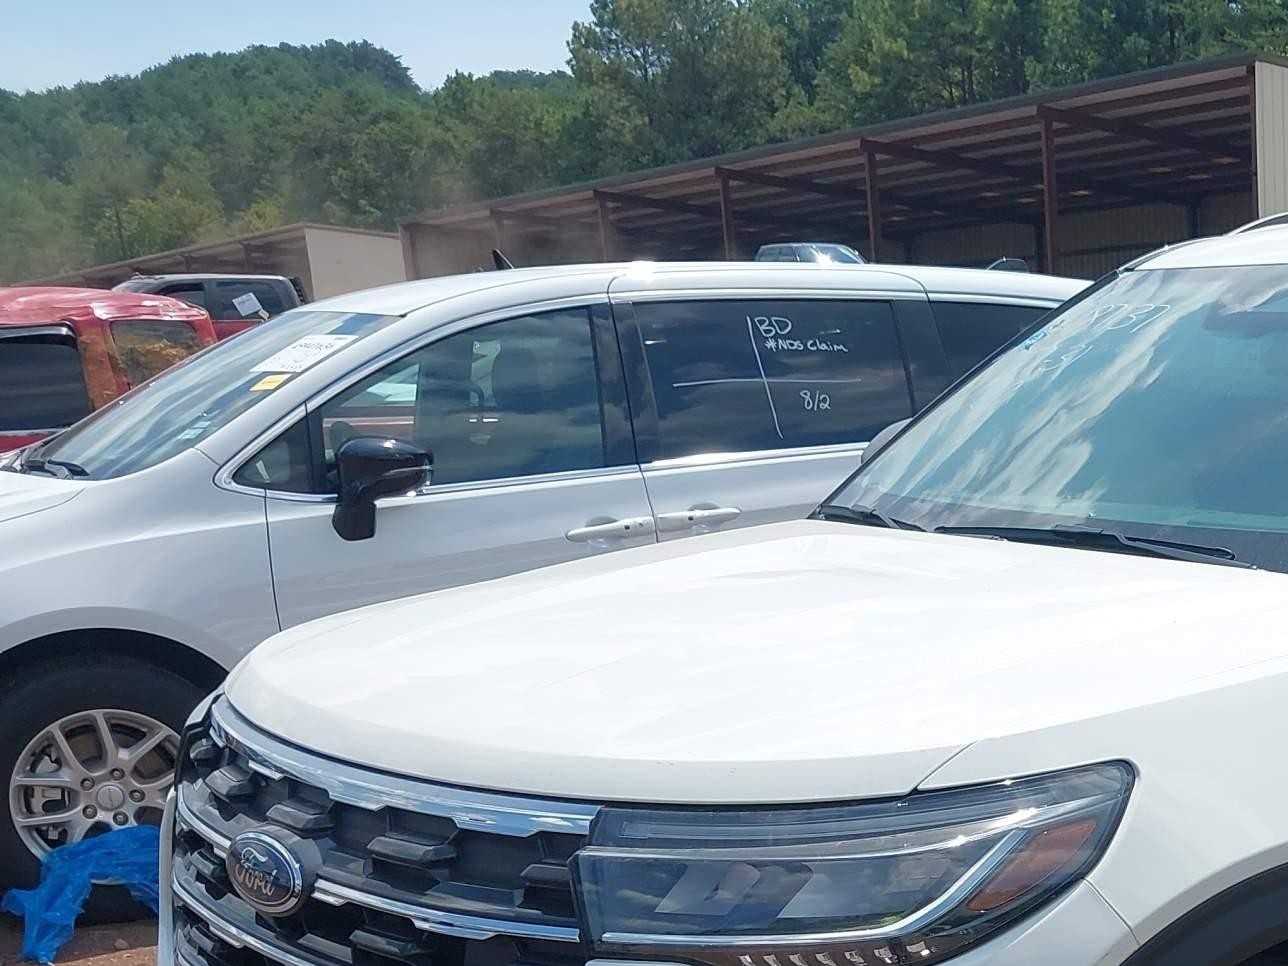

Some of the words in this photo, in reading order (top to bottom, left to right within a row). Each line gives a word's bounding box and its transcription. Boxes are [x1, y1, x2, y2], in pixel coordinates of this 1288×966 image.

[754, 316, 792, 337] BD
[807, 338, 849, 352] Claim
[799, 390, 832, 411] 8/2
[235, 846, 278, 897] Ford
